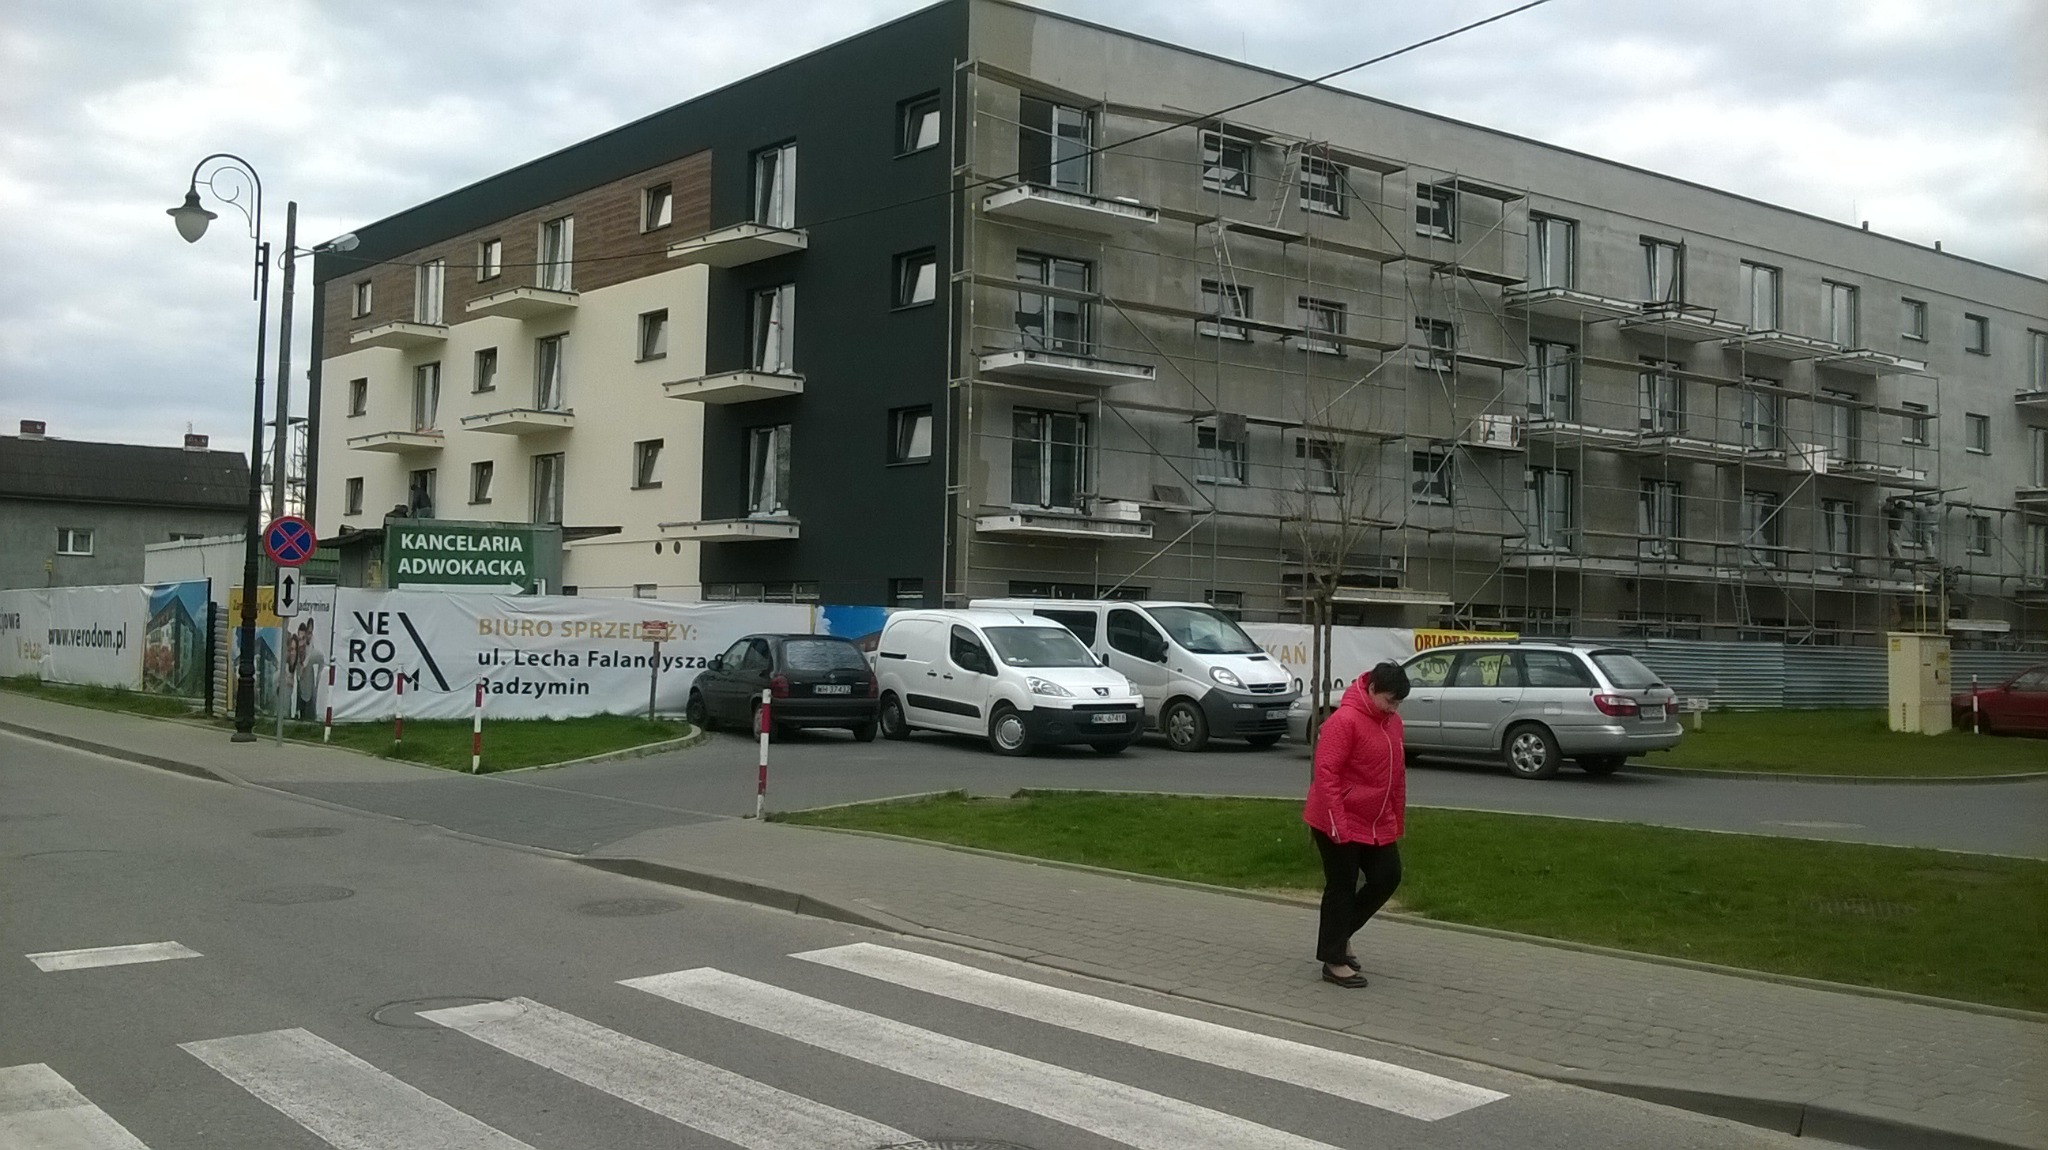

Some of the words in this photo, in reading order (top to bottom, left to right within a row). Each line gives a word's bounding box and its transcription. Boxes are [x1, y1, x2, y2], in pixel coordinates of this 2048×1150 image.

[401, 533, 523, 552] KANCELARIA
[397, 558, 526, 576] ADWOKACKA
[298, 599, 330, 614] adzymina
[0, 607, 20, 636] jowa
[478, 618, 553, 637] BIURO
[560, 620, 697, 641] SPRZEDŻY:
[48, 621, 127, 656] www.verodom.pl
[349, 639, 396, 663] RO
[478, 647, 507, 666] ul.
[514, 649, 579, 667] Lecha
[347, 667, 420, 692] DOM
[478, 676, 590, 699] Radzymin
